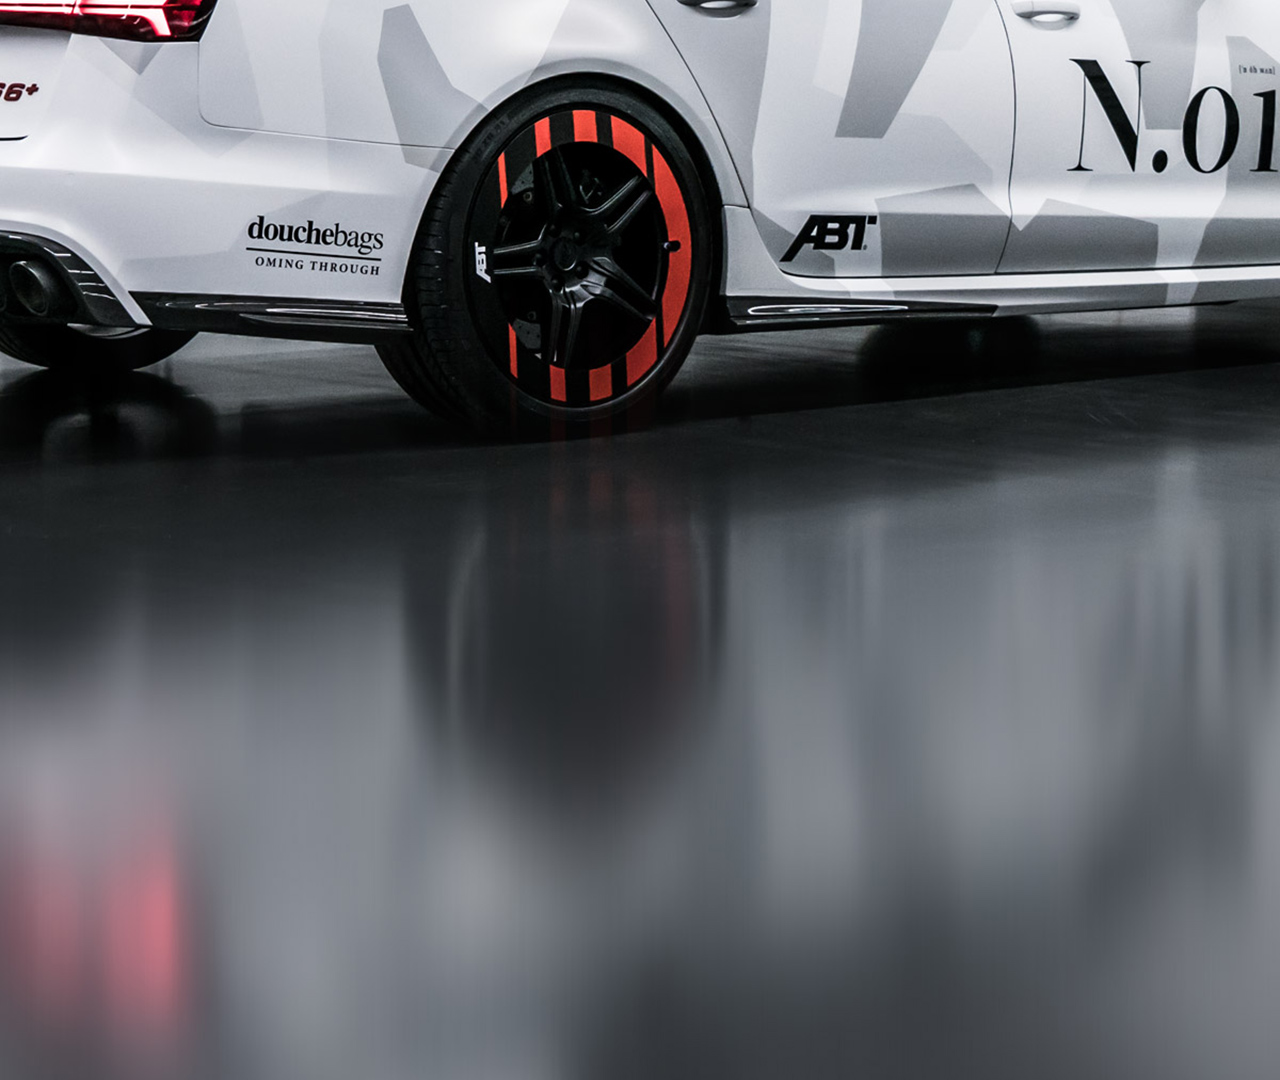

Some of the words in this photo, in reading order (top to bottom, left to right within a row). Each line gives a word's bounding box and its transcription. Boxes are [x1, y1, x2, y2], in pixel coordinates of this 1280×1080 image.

[1066, 58, 1279, 175] N.01
[247, 215, 384, 255] douchebags
[779, 214, 878, 263] ABT
[255, 256, 304, 270] OMING
[309, 261, 380, 276] THROUGH
[474, 241, 492, 284] ABT
